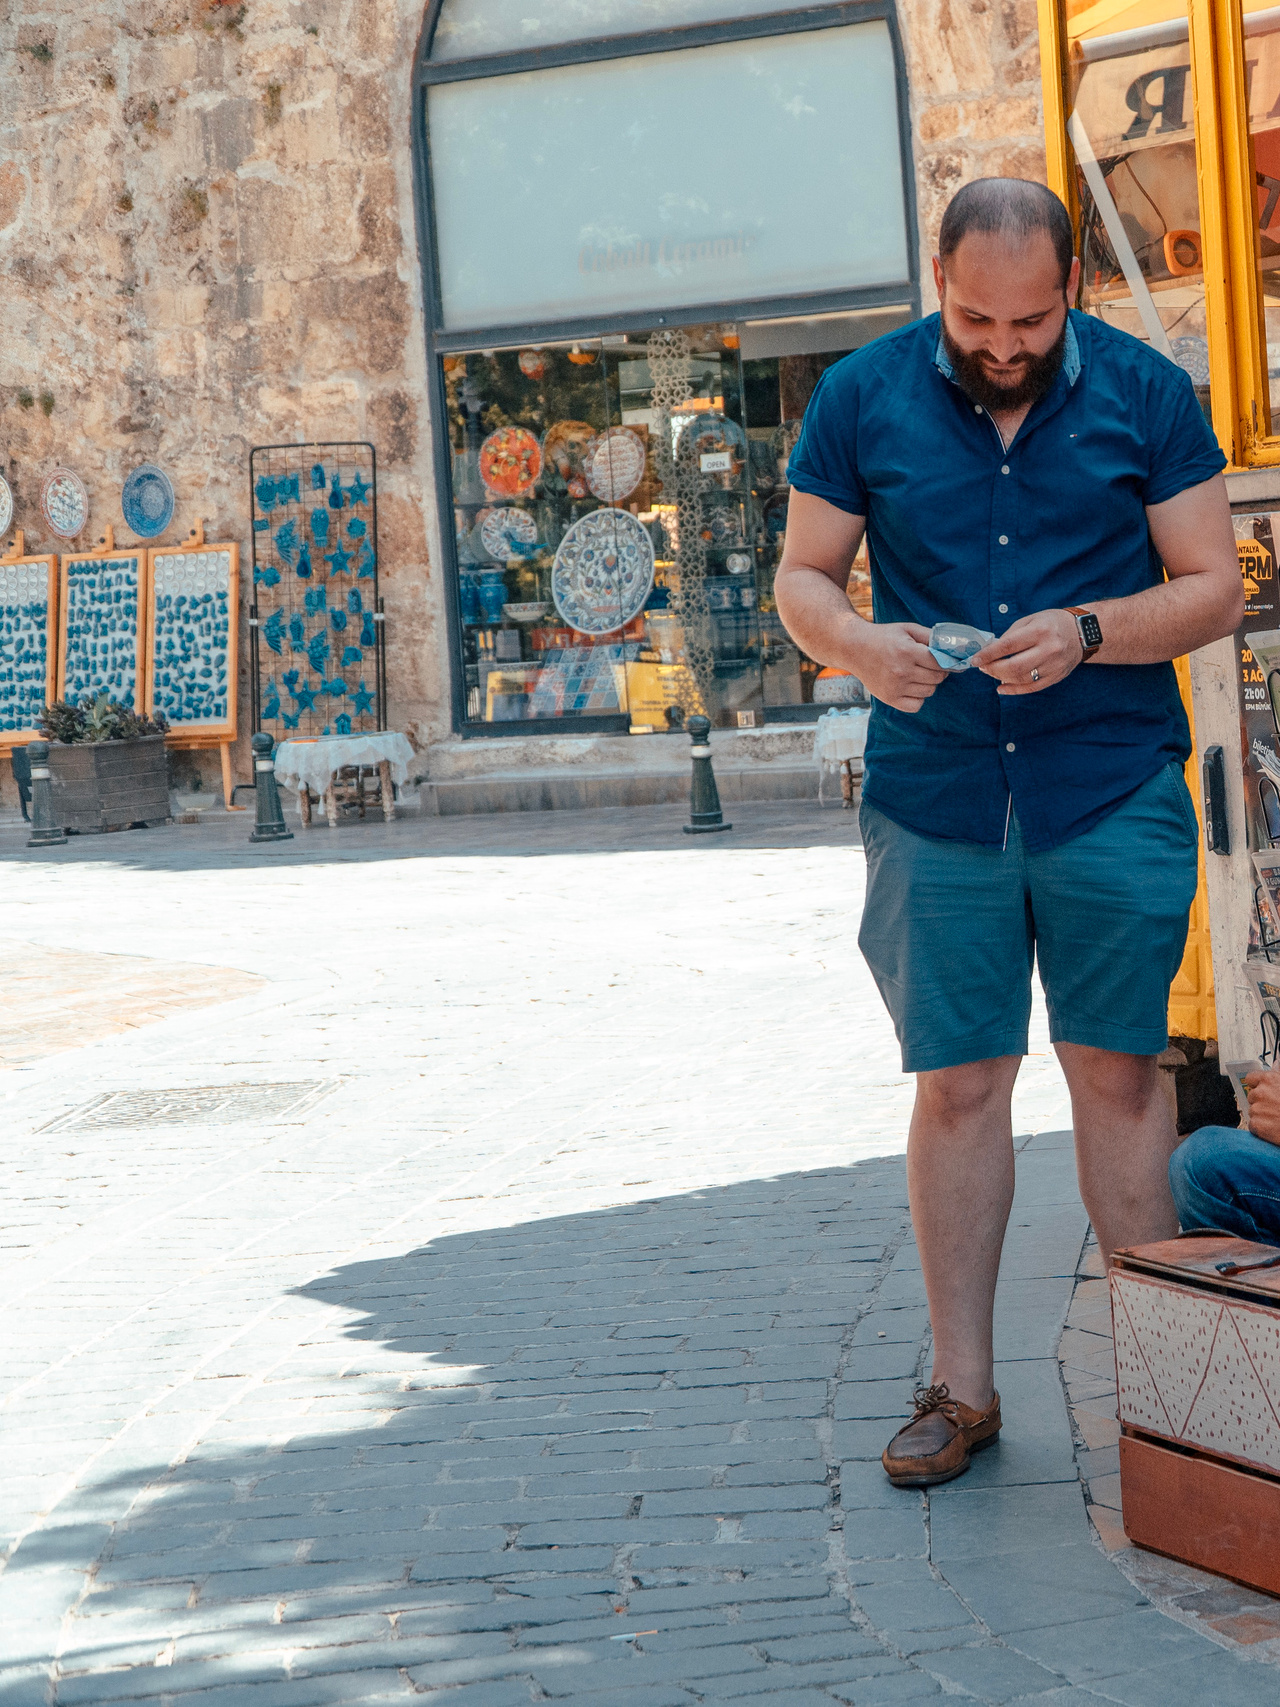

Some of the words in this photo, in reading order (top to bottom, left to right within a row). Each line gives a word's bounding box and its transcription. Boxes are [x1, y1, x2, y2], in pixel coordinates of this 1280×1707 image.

[706, 460, 726, 469] OPEN
[1241, 649, 1253, 663] 20
[1243, 669, 1249, 682] 3
[1244, 687, 1266, 700] 21:00
